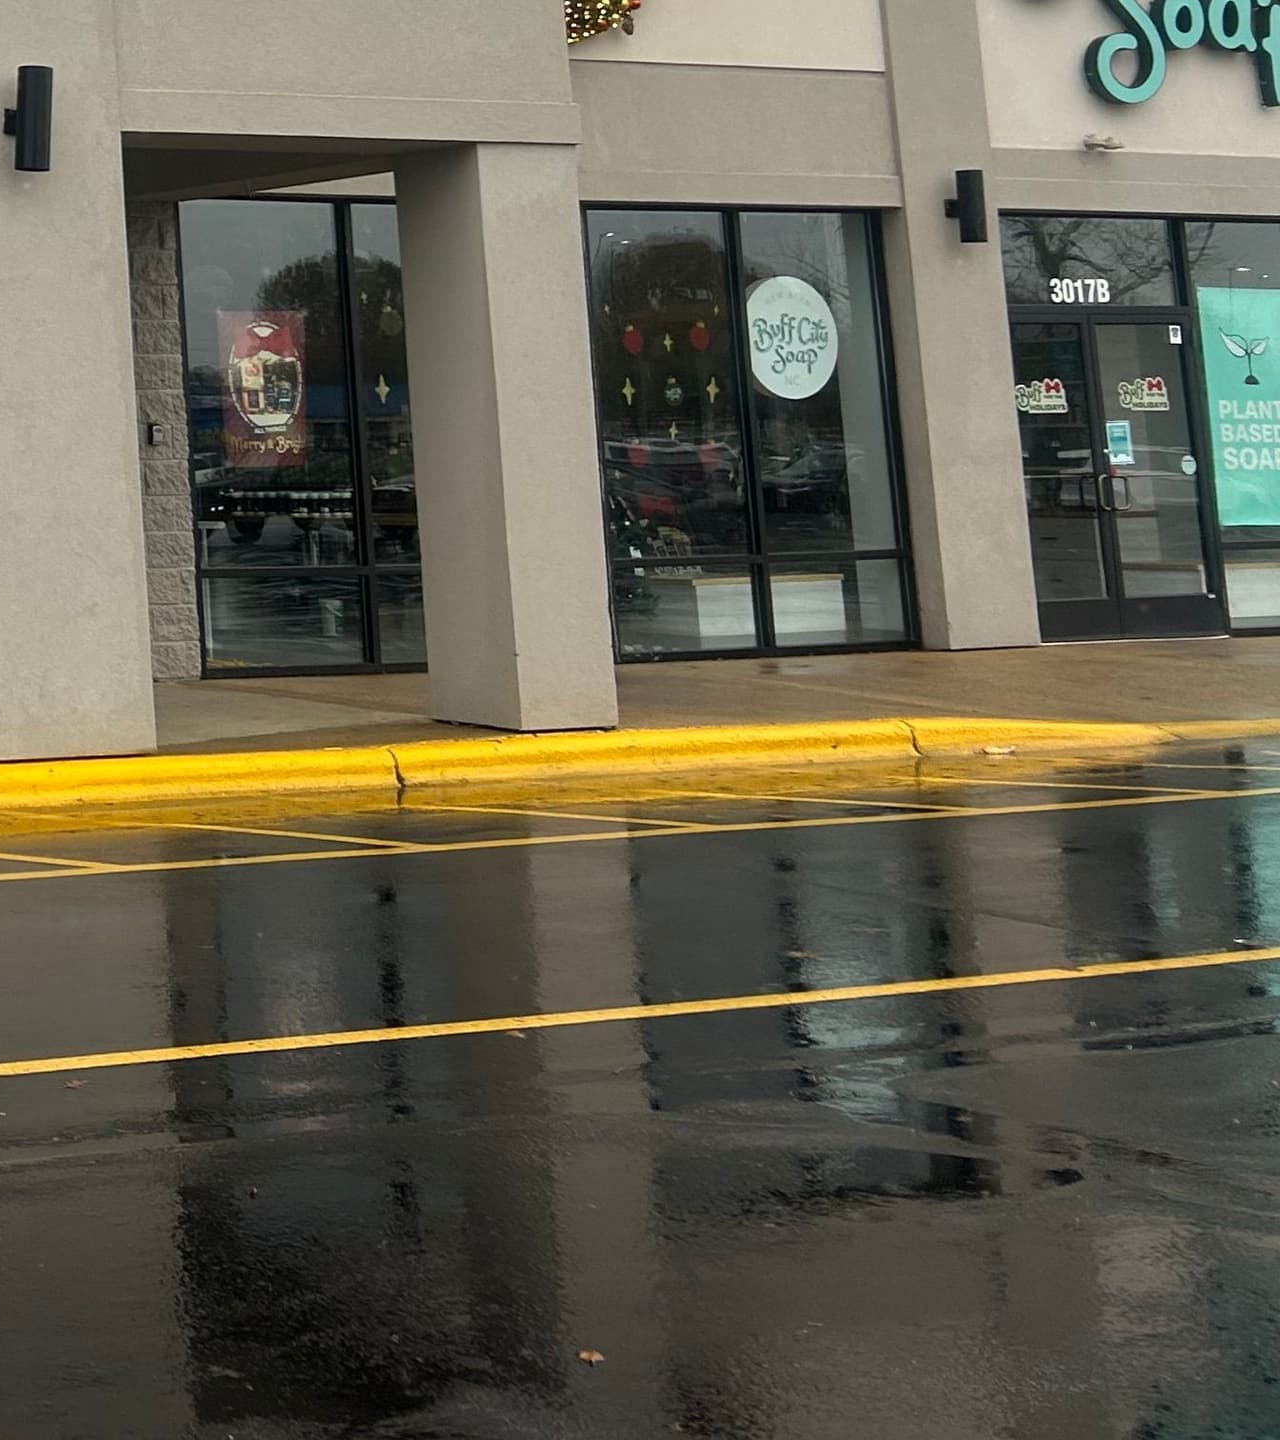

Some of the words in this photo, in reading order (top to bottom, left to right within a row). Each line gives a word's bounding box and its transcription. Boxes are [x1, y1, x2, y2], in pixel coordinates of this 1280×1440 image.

[1049, 278, 1110, 303] 3017B
[752, 313, 796, 352] Buff
[797, 317, 828, 350] City
[771, 345, 818, 374] Soap
